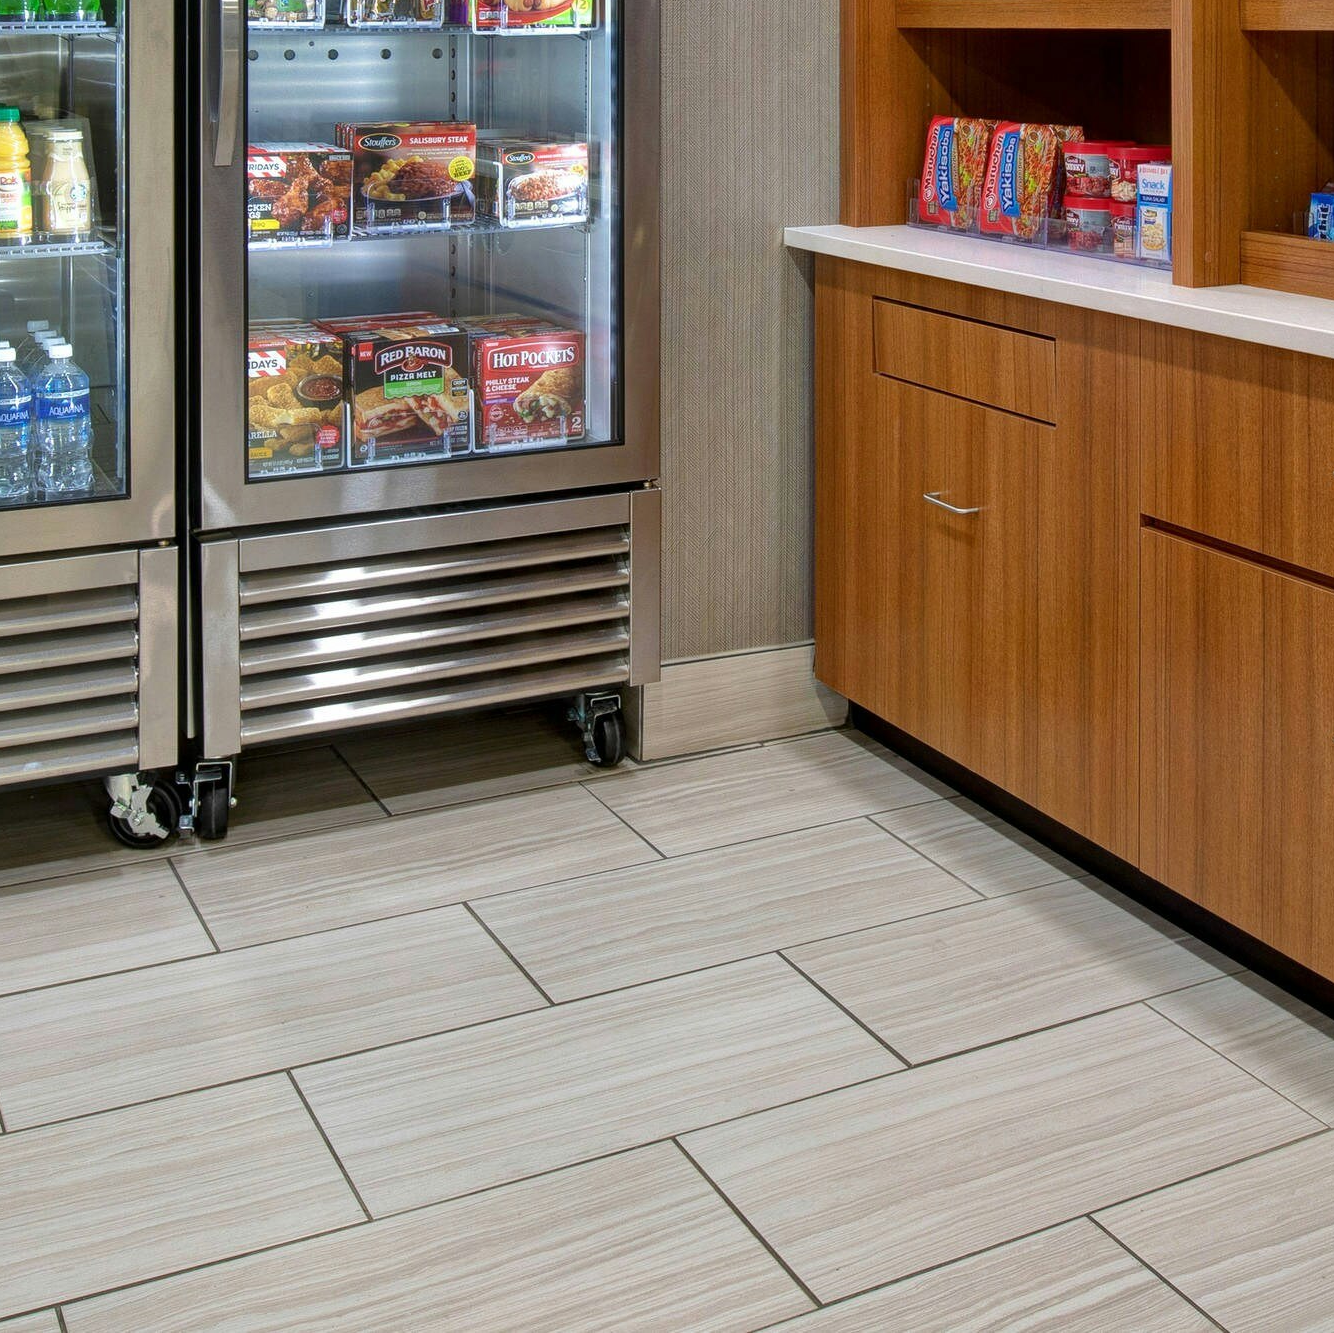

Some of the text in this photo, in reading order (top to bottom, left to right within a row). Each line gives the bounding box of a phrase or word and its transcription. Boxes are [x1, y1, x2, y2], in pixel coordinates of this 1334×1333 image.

[362, 136, 398, 149] Stouffer's
[409, 134, 468, 145] SALISBURY STEAK
[248, 163, 280, 172] RIDAYS
[938, 129, 952, 205] Yakisoba
[1002, 136, 1017, 212] Yakisoba
[1142, 178, 1165, 190] Snack
[359, 350, 372, 359] NEW
[380, 345, 447, 368] RED BARON
[493, 346, 576, 369] HOT POCKETS
[390, 370, 436, 381] PIZZA MELT
[485, 376, 530, 386] PHILLY STEAK
[485, 382, 518, 392] & CHEESE
[571, 416, 582, 430] 2
